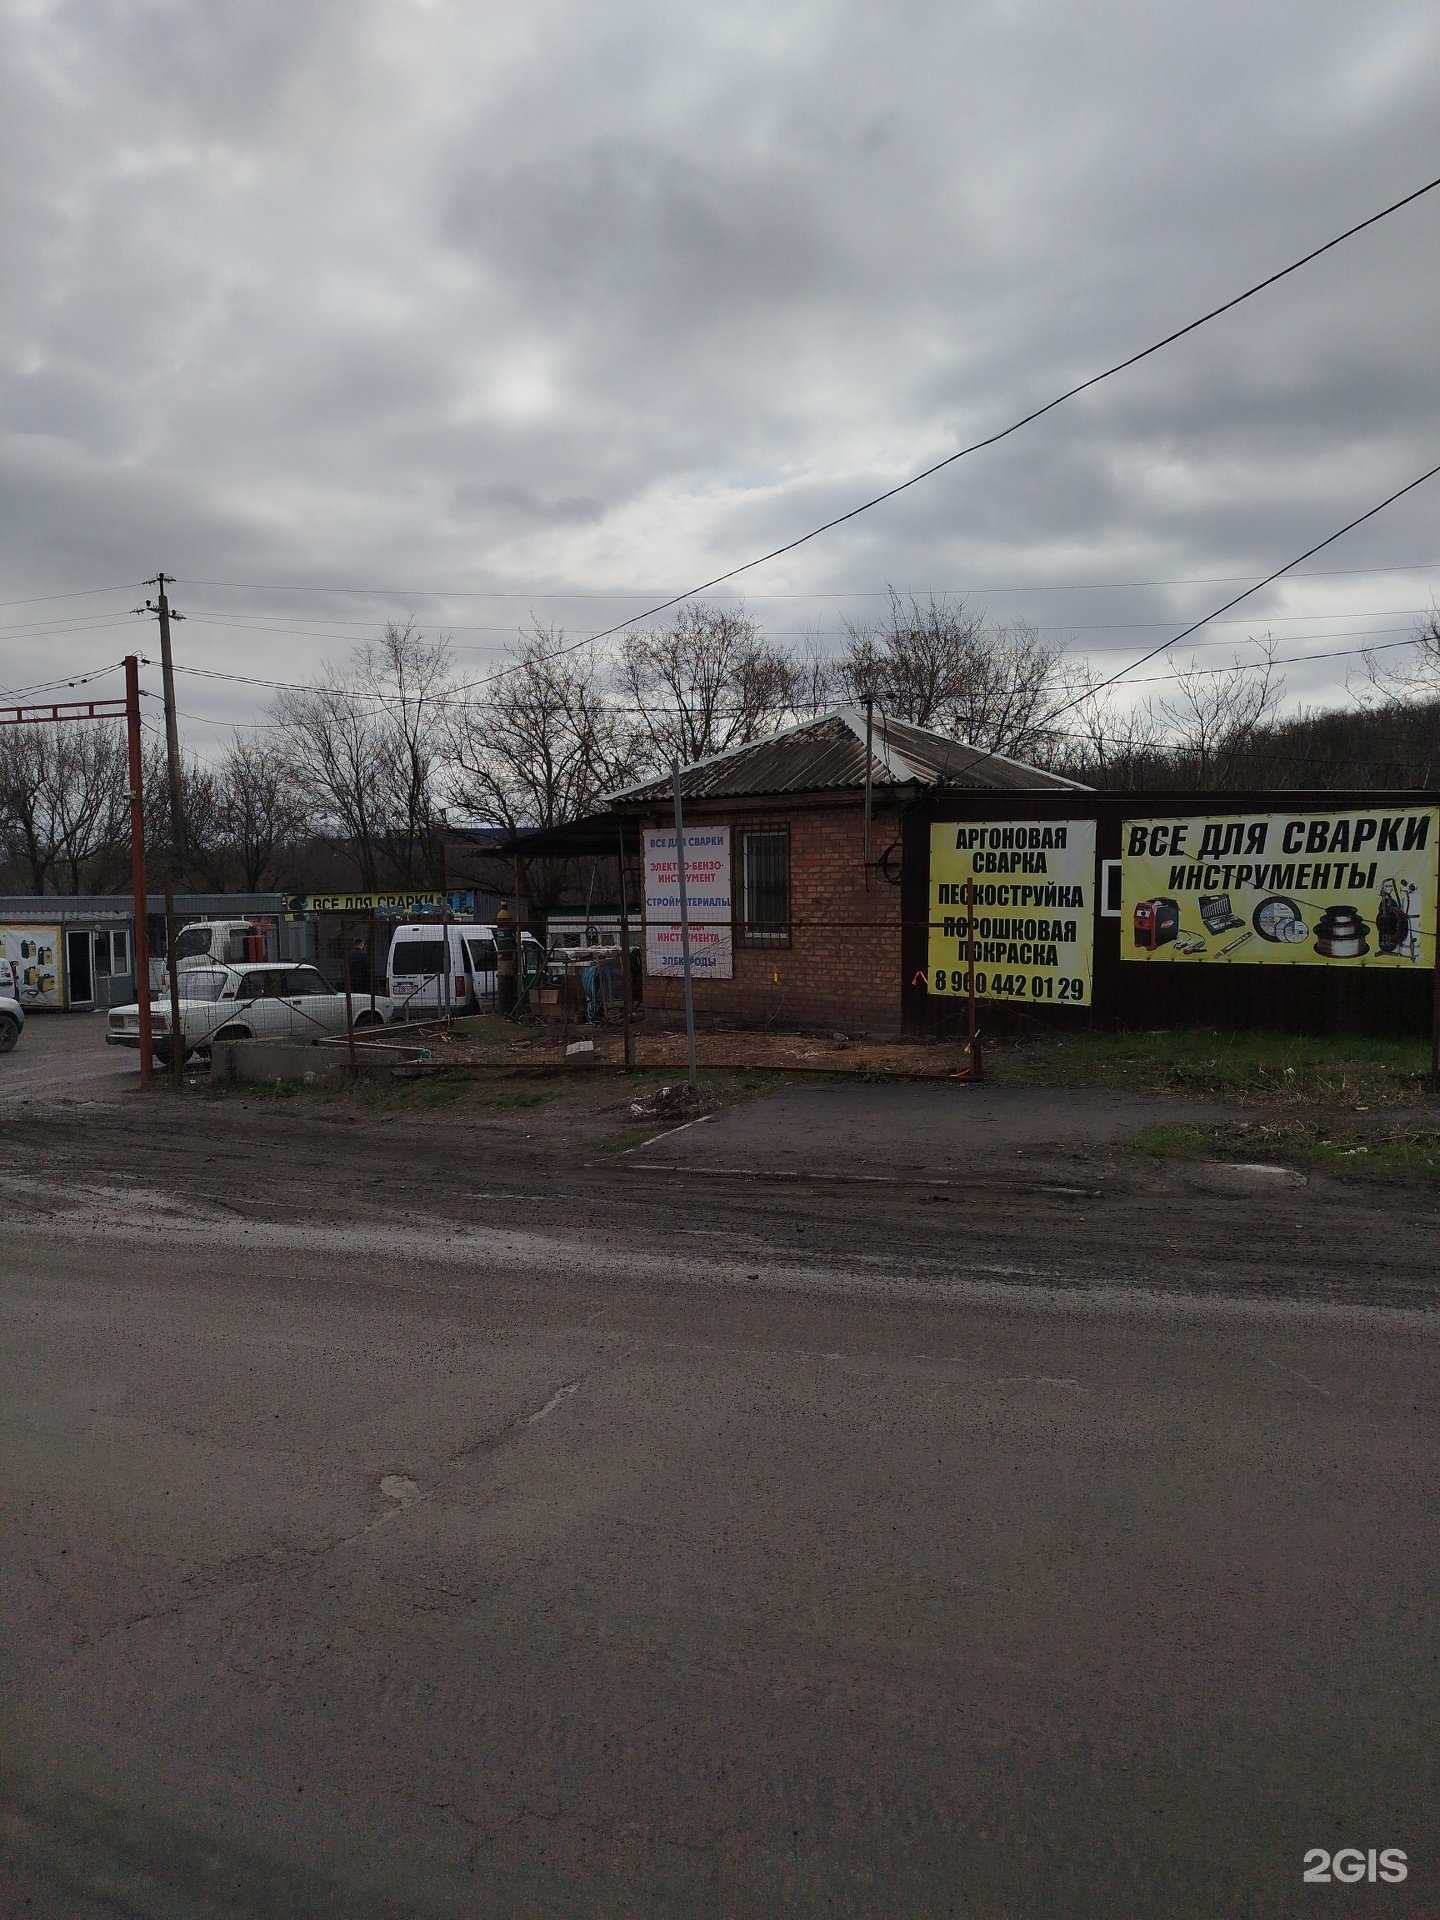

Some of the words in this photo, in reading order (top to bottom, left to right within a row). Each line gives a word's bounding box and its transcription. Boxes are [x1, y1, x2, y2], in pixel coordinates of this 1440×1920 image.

[650, 838, 666, 848] ВСЕ
[688, 836, 724, 847] СВАРКИ
[956, 827, 1067, 849] АРГОНОВАЯ
[1128, 825, 1188, 857] ВСЕ
[1198, 823, 1268, 861] ДЛЯ
[1282, 815, 1430, 854] СВАРКИ
[972, 851, 1047, 873] СВАРКА
[1168, 862, 1377, 891] ИНСТРУМЕНТЫ
[313, 896, 339, 910] ВСЕ
[346, 895, 372, 909] ДЛЯ
[378, 894, 434, 909] СВАРКИ
[935, 970, 946, 991] 8
[991, 974, 1027, 996] 442
[1031, 976, 1053, 998] 01
[1058, 978, 1083, 1001] 29
